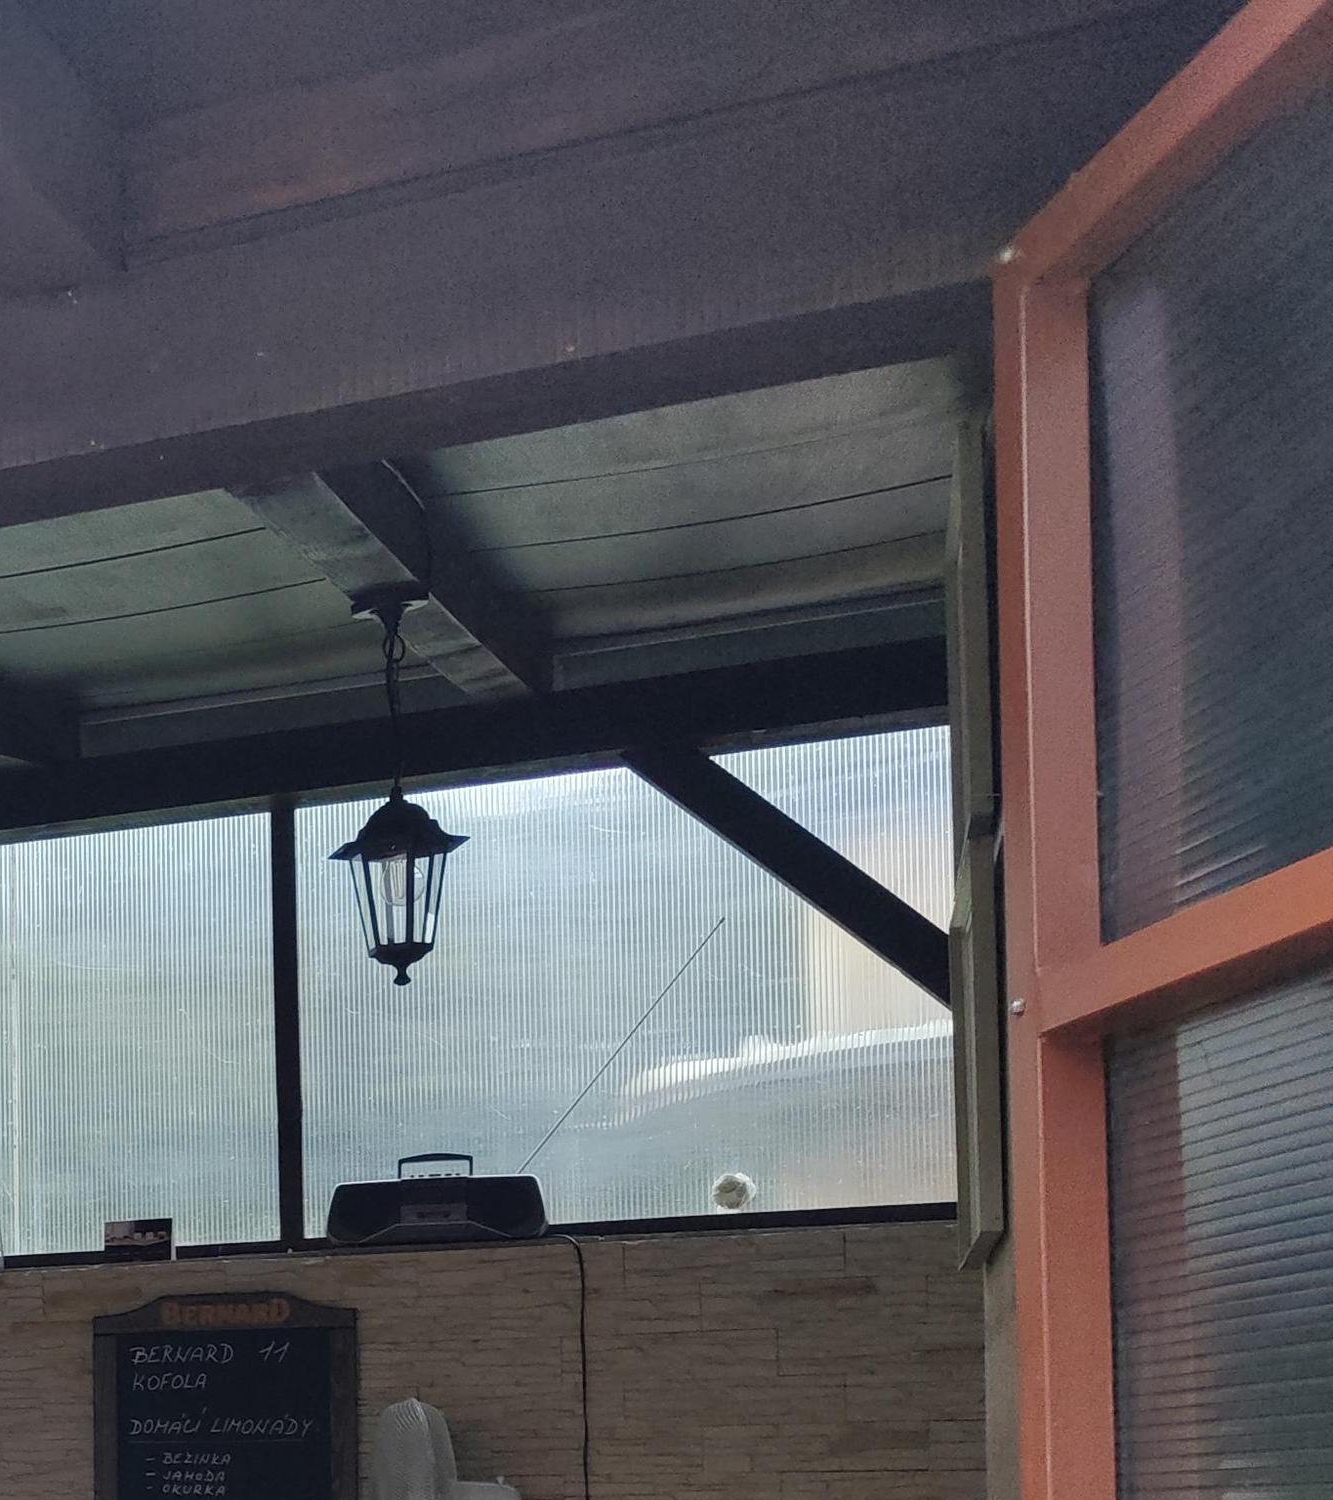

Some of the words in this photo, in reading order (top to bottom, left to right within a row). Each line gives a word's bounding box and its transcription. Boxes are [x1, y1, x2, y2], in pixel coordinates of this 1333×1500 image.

[161, 1298, 292, 1325] BERNARD
[130, 1343, 234, 1365] BERNARD
[258, 1340, 290, 1363] 11
[132, 1371, 207, 1391] KOFOLA
[129, 1406, 208, 1436] DOMÁCÍ
[210, 1413, 314, 1438] LIMONÁDY
[162, 1470, 226, 1482] JAHODA
[162, 1484, 226, 1496] OKURKA
